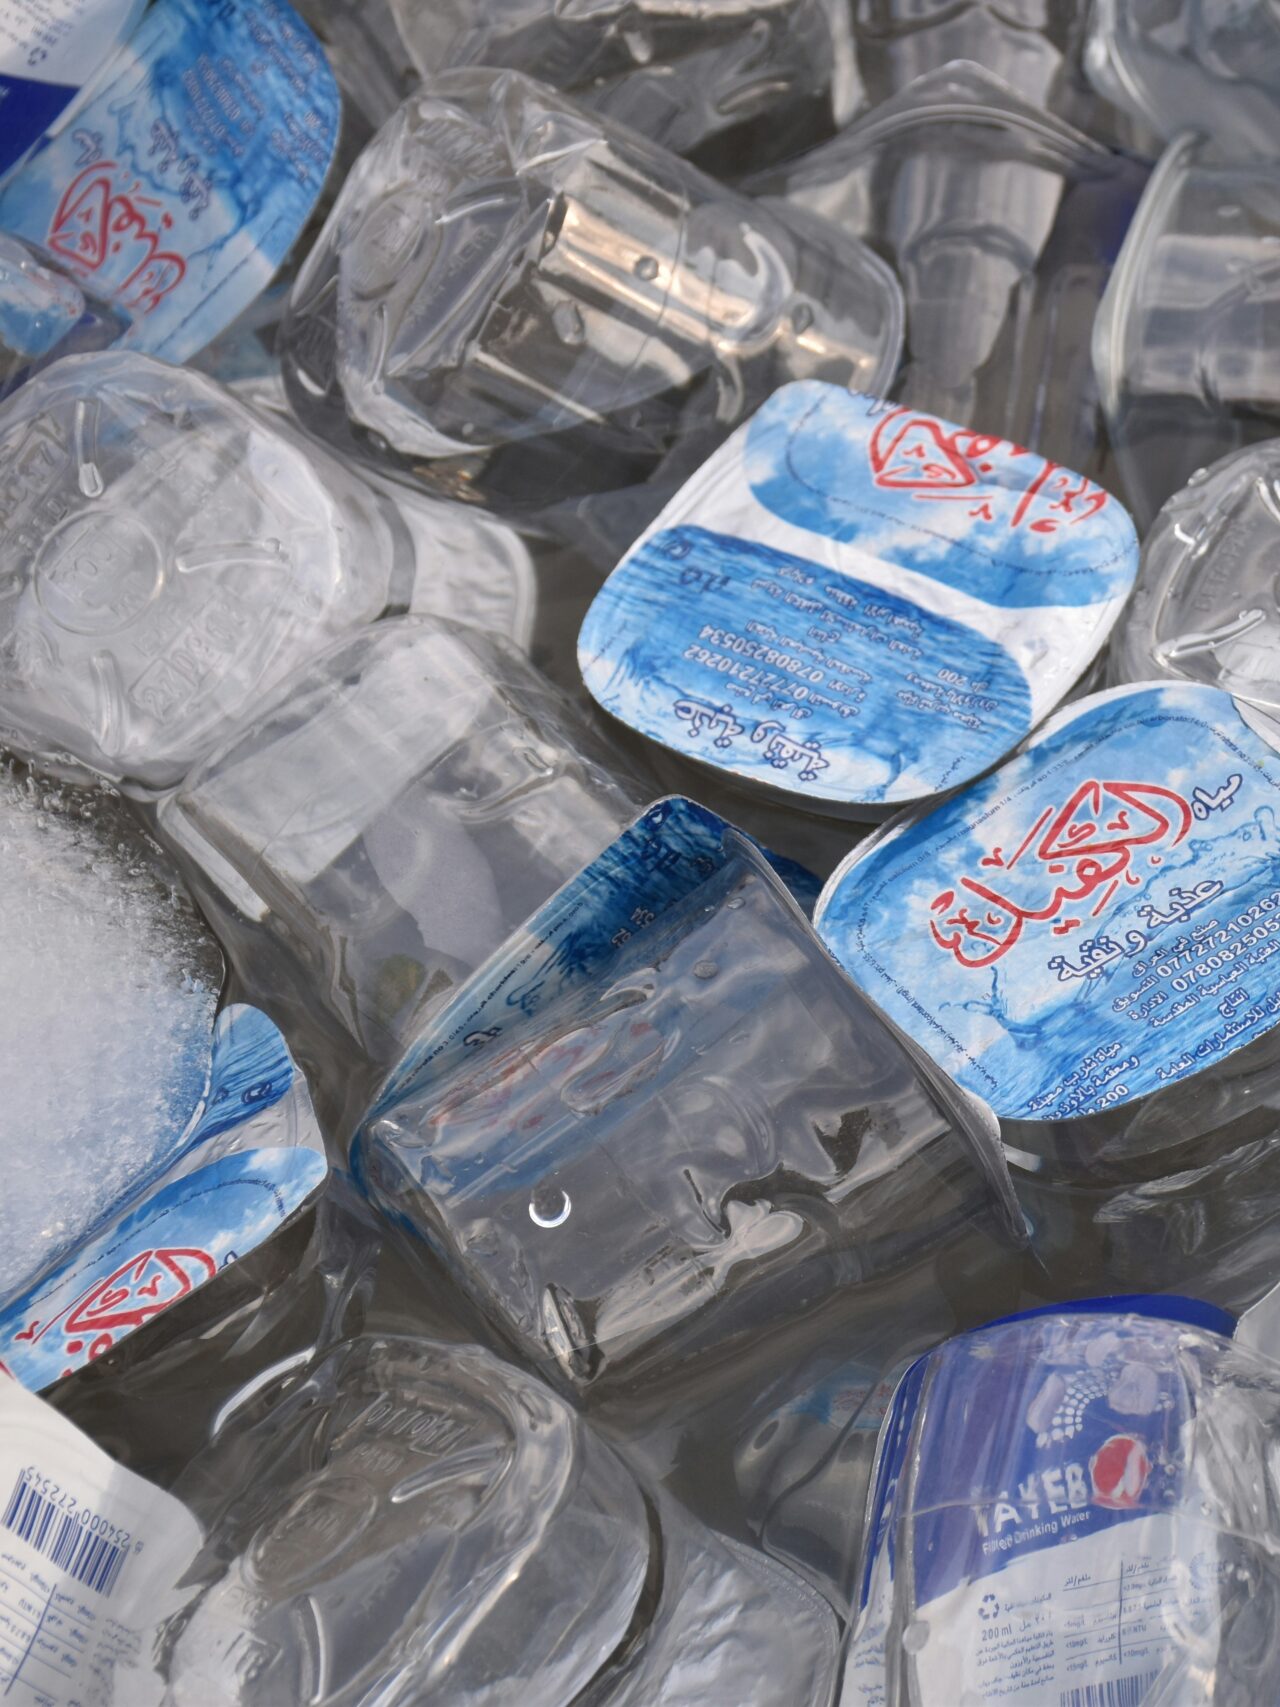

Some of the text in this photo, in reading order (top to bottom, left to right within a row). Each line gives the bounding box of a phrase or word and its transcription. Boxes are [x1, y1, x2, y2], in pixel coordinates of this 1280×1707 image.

[685, 639, 807, 703] 07727210262
[700, 621, 823, 685] 07808250534
[936, 666, 970, 686] 200
[669, 689, 744, 748] عذبة
[1188, 770, 1248, 819] مياه
[928, 777, 1194, 968] الكفيل
[1050, 871, 1226, 989] عذبة ونقية
[1130, 917, 1219, 976] صنع في العراق
[1110, 975, 1159, 1011] التسويق
[1199, 962, 1248, 998] العباسية
[1129, 991, 1168, 1021] الادارة
[1150, 993, 1199, 1027] المقدسة
[1217, 989, 1250, 1017] انتاج
[1093, 1055, 1139, 1087] ومعقمة
[1156, 1052, 1194, 1080] العامة
[1098, 1083, 1128, 1106] 200
[22, 1467, 78, 1510] 272545
[80, 1509, 128, 1545] 254000
[1060, 1510, 1091, 1526] Water
[981, 1624, 1012, 1640] 200 ml
